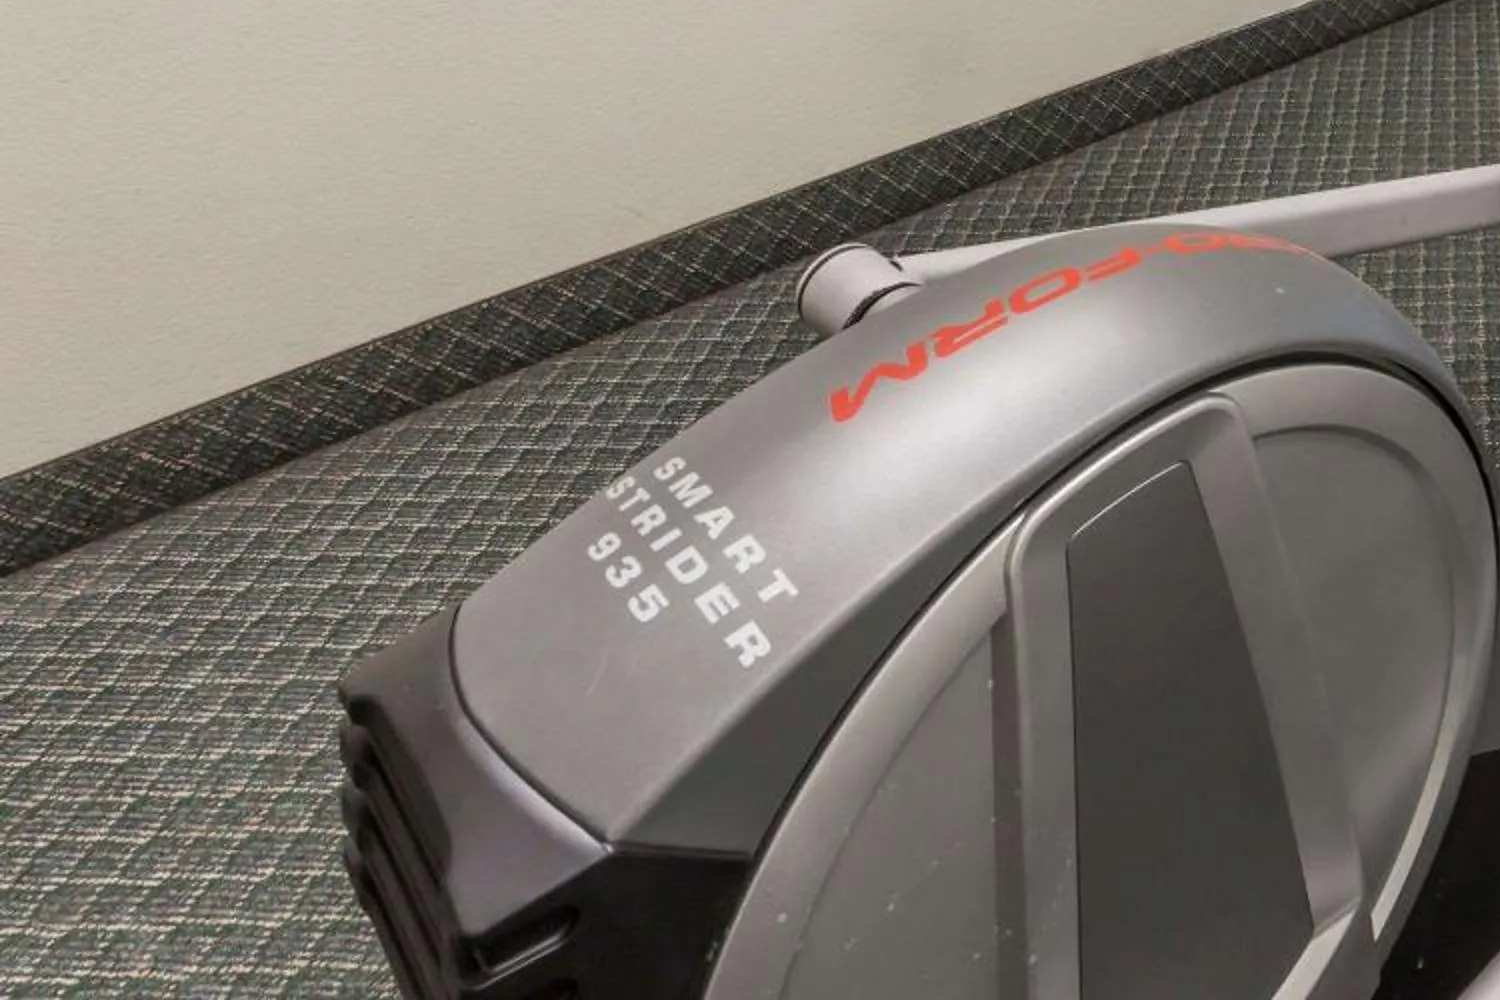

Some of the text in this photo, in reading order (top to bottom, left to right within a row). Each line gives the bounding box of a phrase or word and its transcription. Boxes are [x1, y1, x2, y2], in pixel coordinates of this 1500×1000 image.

[588, 532, 670, 623] 935
[606, 475, 772, 668] STRIDER
[653, 456, 799, 603] SMART
